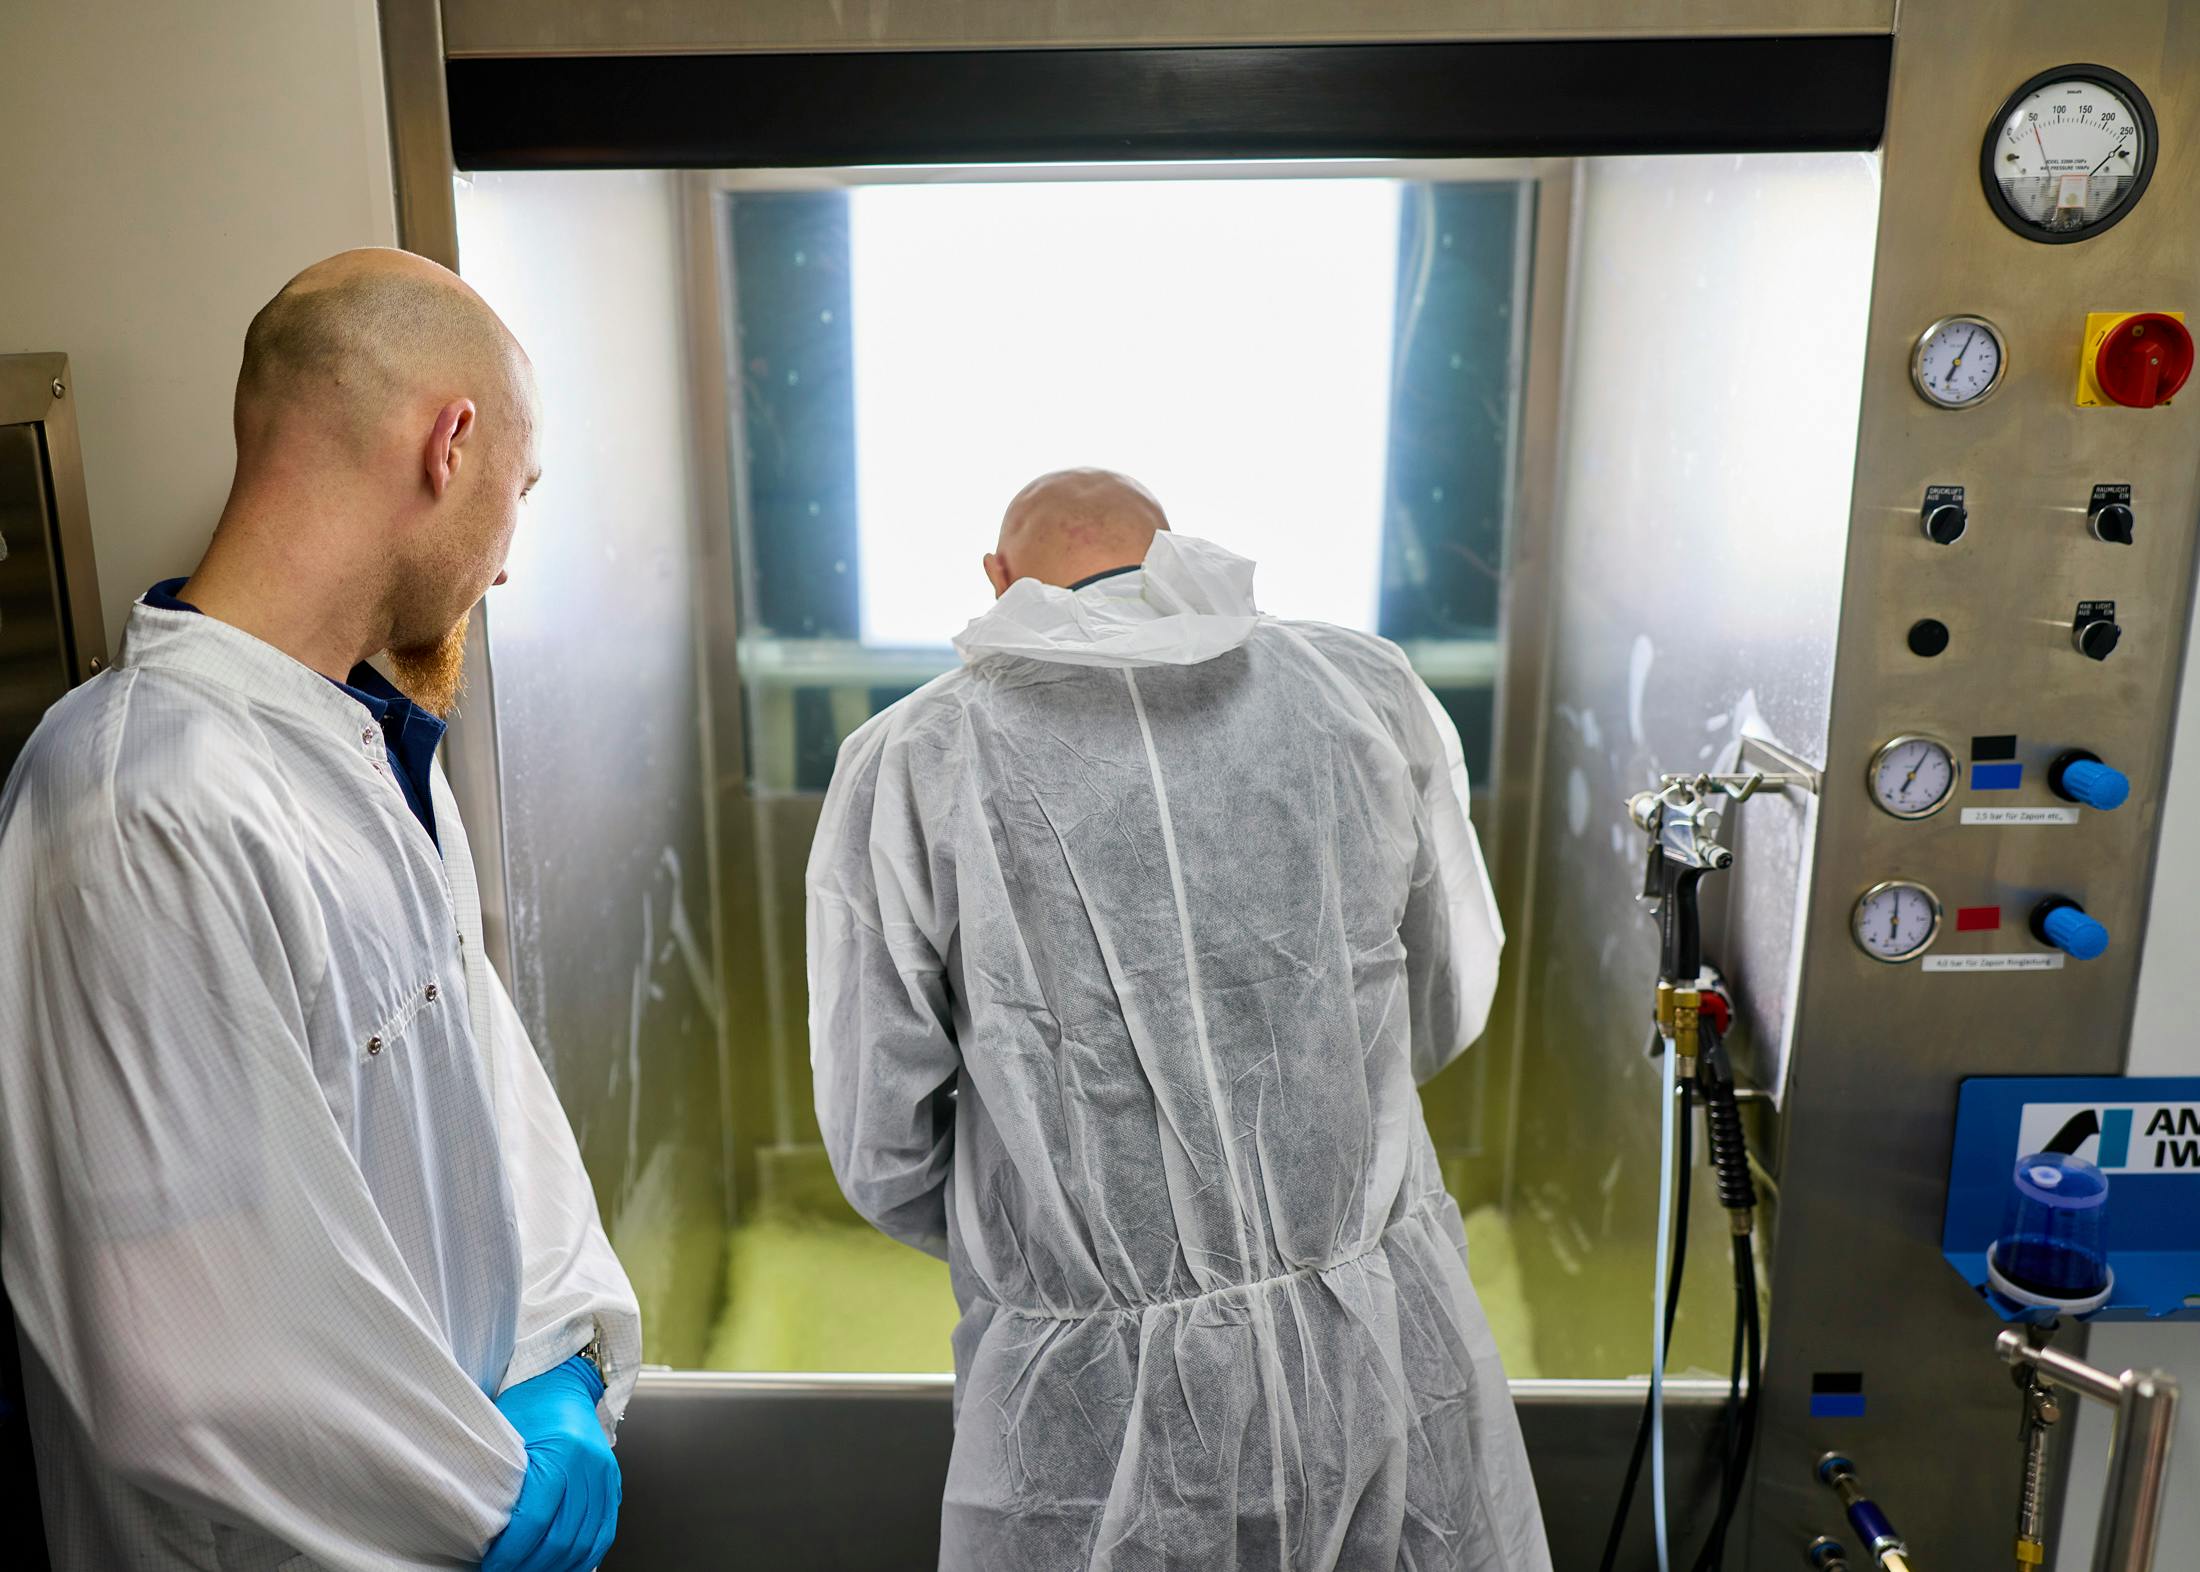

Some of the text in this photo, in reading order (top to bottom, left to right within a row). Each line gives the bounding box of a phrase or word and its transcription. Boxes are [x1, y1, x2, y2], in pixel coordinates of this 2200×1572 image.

[2053, 105, 2066, 114] 100
[2079, 105, 2092, 113] 150
[2028, 113, 2038, 121] 50
[2101, 113, 2115, 121] 200
[2120, 127, 2134, 135] 250
[1929, 487, 1963, 495] DRUCKLUFT
[1990, 811, 2002, 820] bar
[2005, 811, 2017, 820] für
[2145, 1108, 2200, 1136] AN
